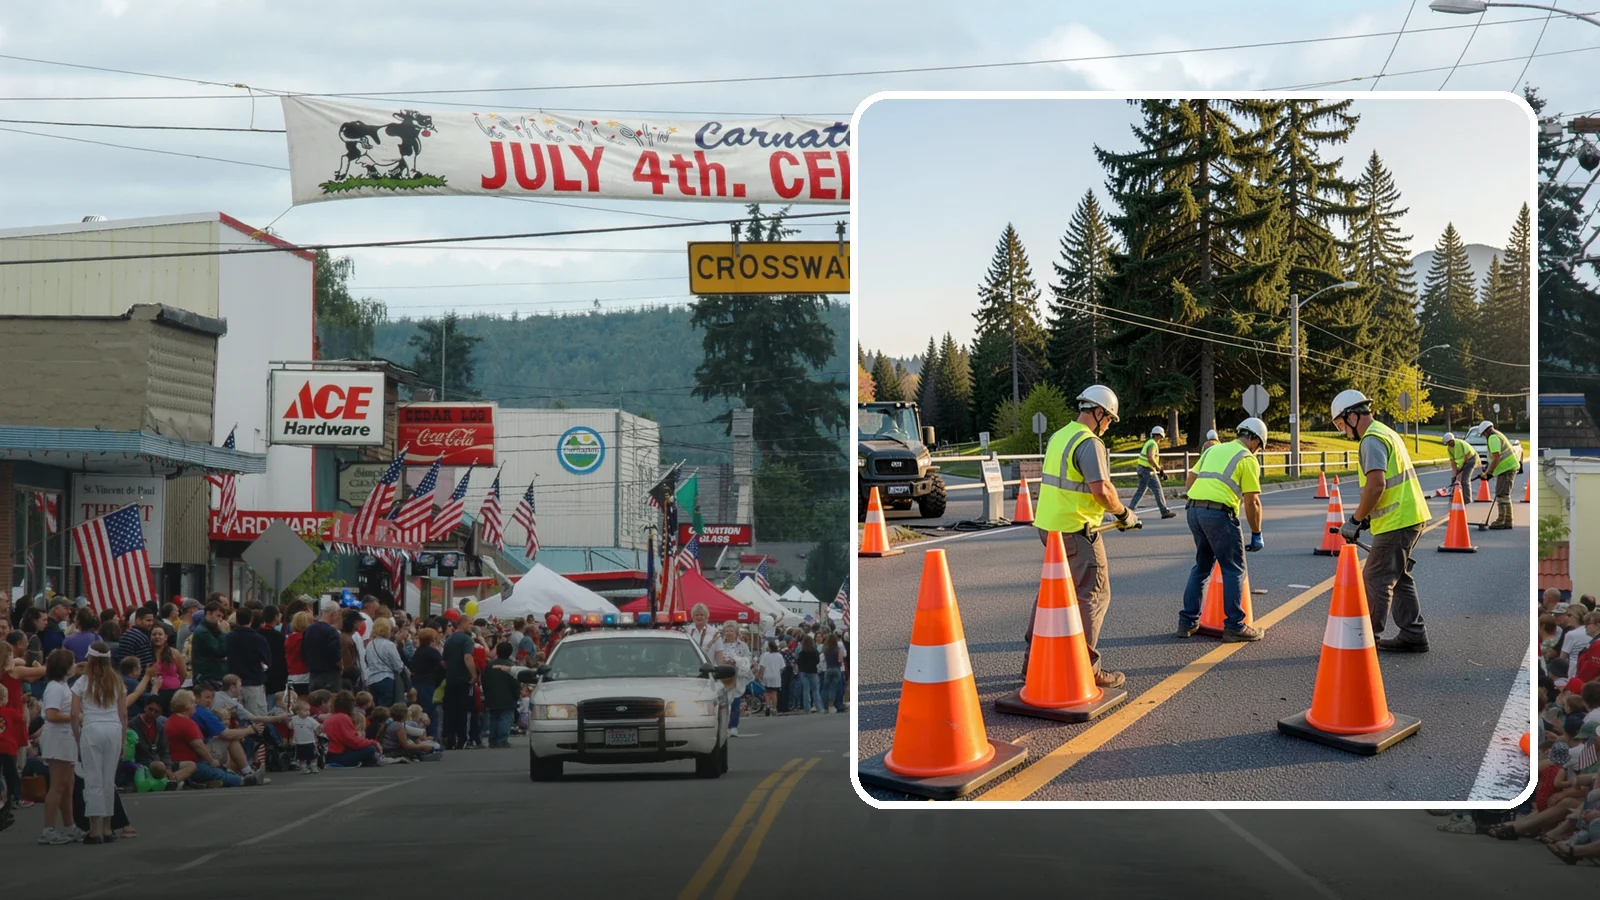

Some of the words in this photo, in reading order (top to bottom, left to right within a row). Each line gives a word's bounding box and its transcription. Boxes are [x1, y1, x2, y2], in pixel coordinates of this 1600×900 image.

[481, 141, 605, 192] JULY
[632, 150, 746, 197] 4th.
[697, 254, 850, 280] CROSSWA
[282, 380, 373, 420] ACE
[406, 410, 452, 422] CEDAR
[461, 410, 485, 422] LOG
[283, 421, 370, 436] Hardware
[416, 428, 477, 447] Coca-Cola
[96, 485, 124, 495] Vincent
[126, 486, 136, 495] de
[138, 486, 155, 495] Paul
[213, 516, 331, 535] HARDARE
[688, 526, 740, 535] CRNATION
[699, 535, 730, 543] GLASS
